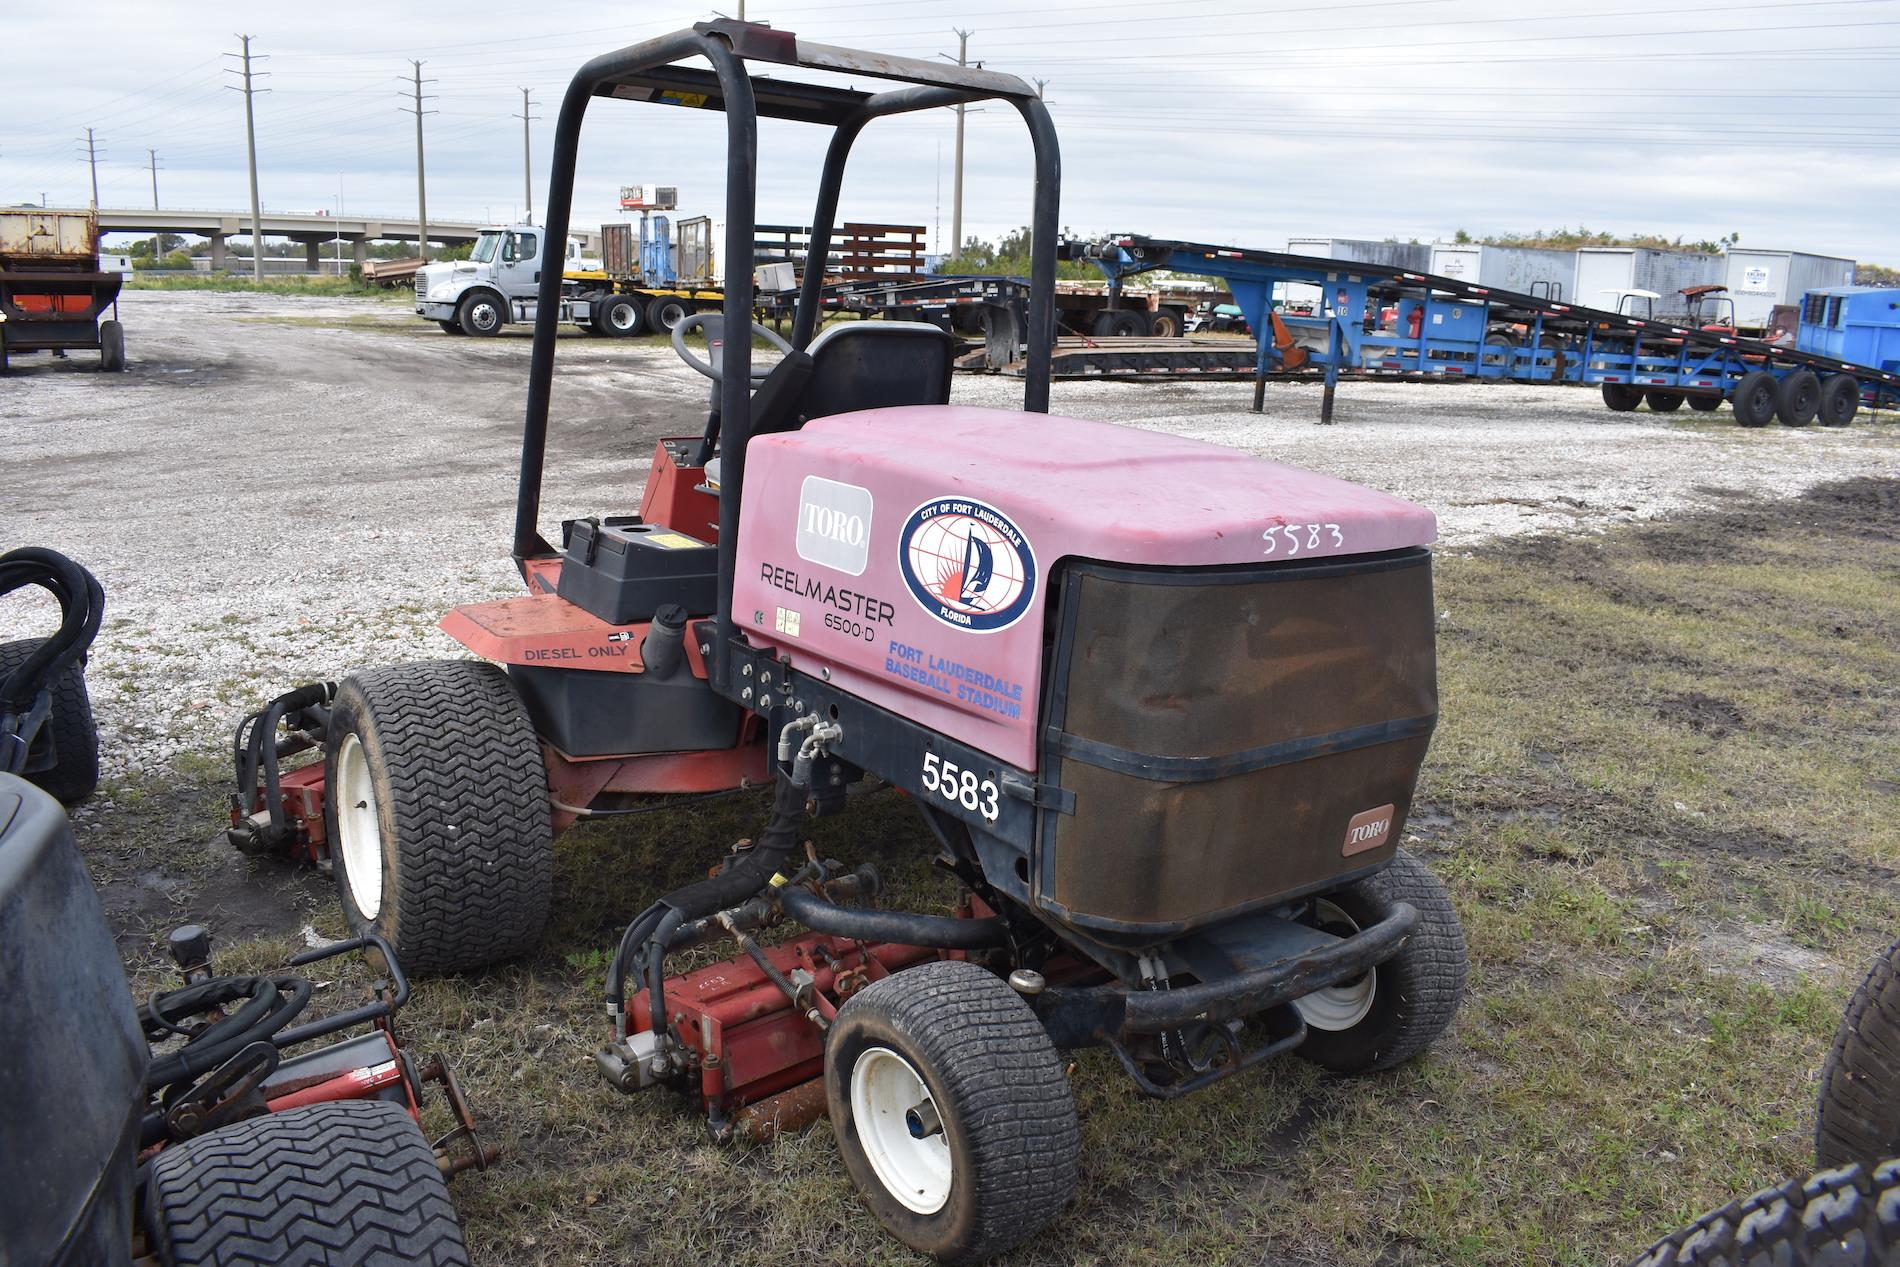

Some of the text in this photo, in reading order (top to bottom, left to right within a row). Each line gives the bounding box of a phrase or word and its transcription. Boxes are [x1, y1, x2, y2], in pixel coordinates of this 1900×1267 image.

[804, 502, 864, 546] TORO
[921, 503, 1022, 548] CITY OF FORT LAUDERDALE
[1262, 523, 1344, 555] 5583
[760, 562, 895, 627] REELMASTER
[940, 606, 972, 626] FLORIDA
[524, 645, 628, 661] DIESEL ONLY
[889, 640, 1023, 701] FORT LAUDERDALE
[885, 658, 1021, 719] BASEBALL STADIUM
[922, 751, 999, 821] 5583
[1350, 818, 1390, 845] TORO
